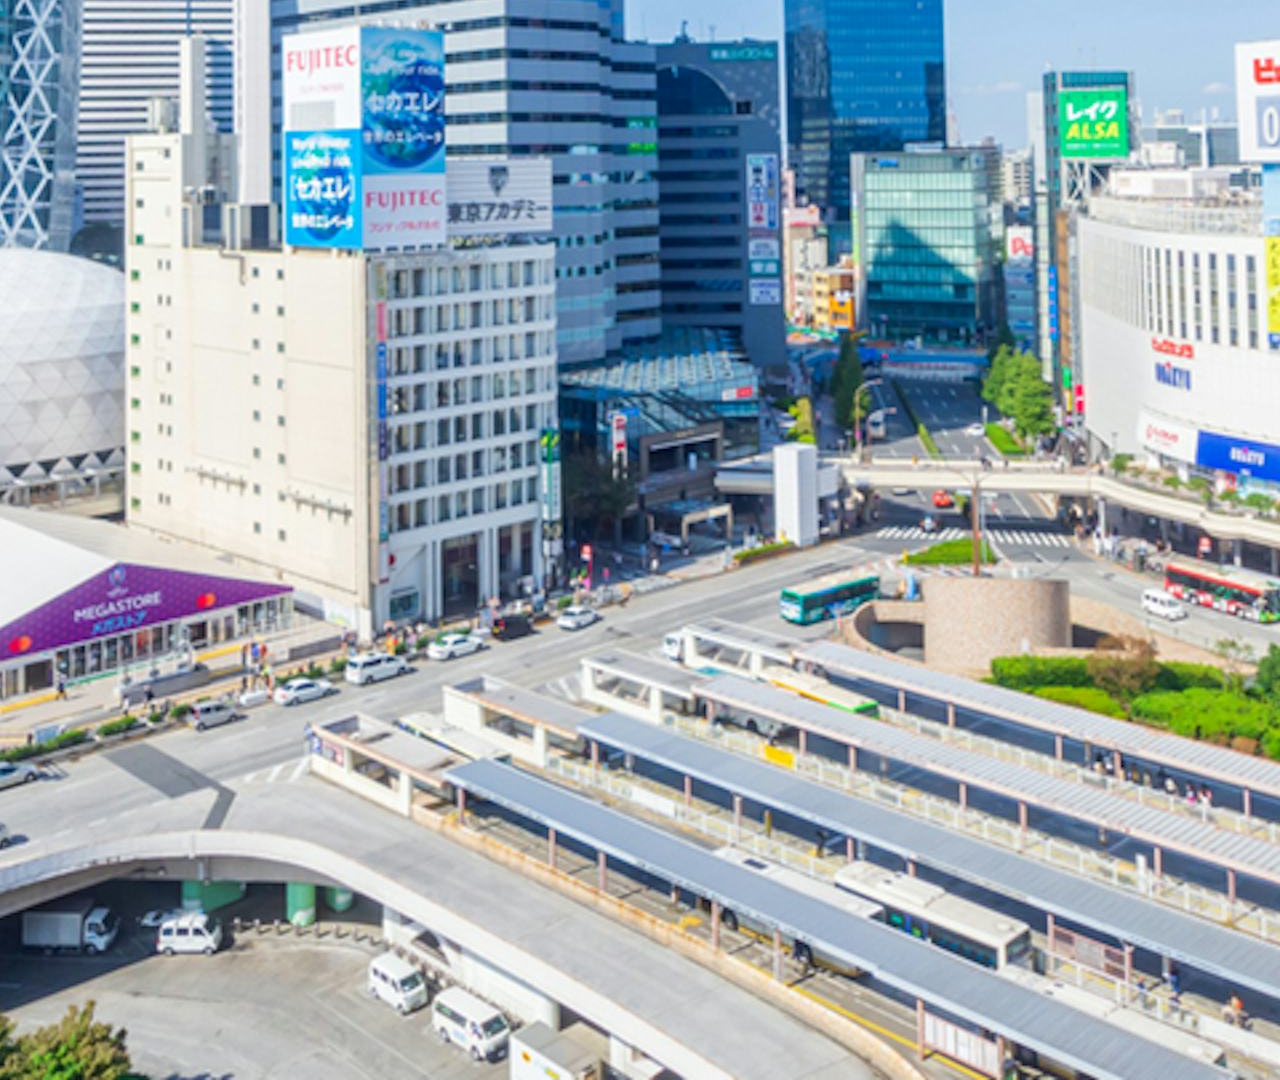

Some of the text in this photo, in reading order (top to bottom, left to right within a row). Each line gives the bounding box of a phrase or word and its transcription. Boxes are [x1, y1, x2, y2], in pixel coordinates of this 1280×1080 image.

[287, 44, 357, 76] FUJITEC
[1065, 101, 1118, 121] レイク
[1065, 121, 1119, 140] ALSA
[365, 189, 443, 212] FUJITEC
[447, 199, 549, 224] 東京アカデミー
[73, 590, 161, 624] MEGASTORE
